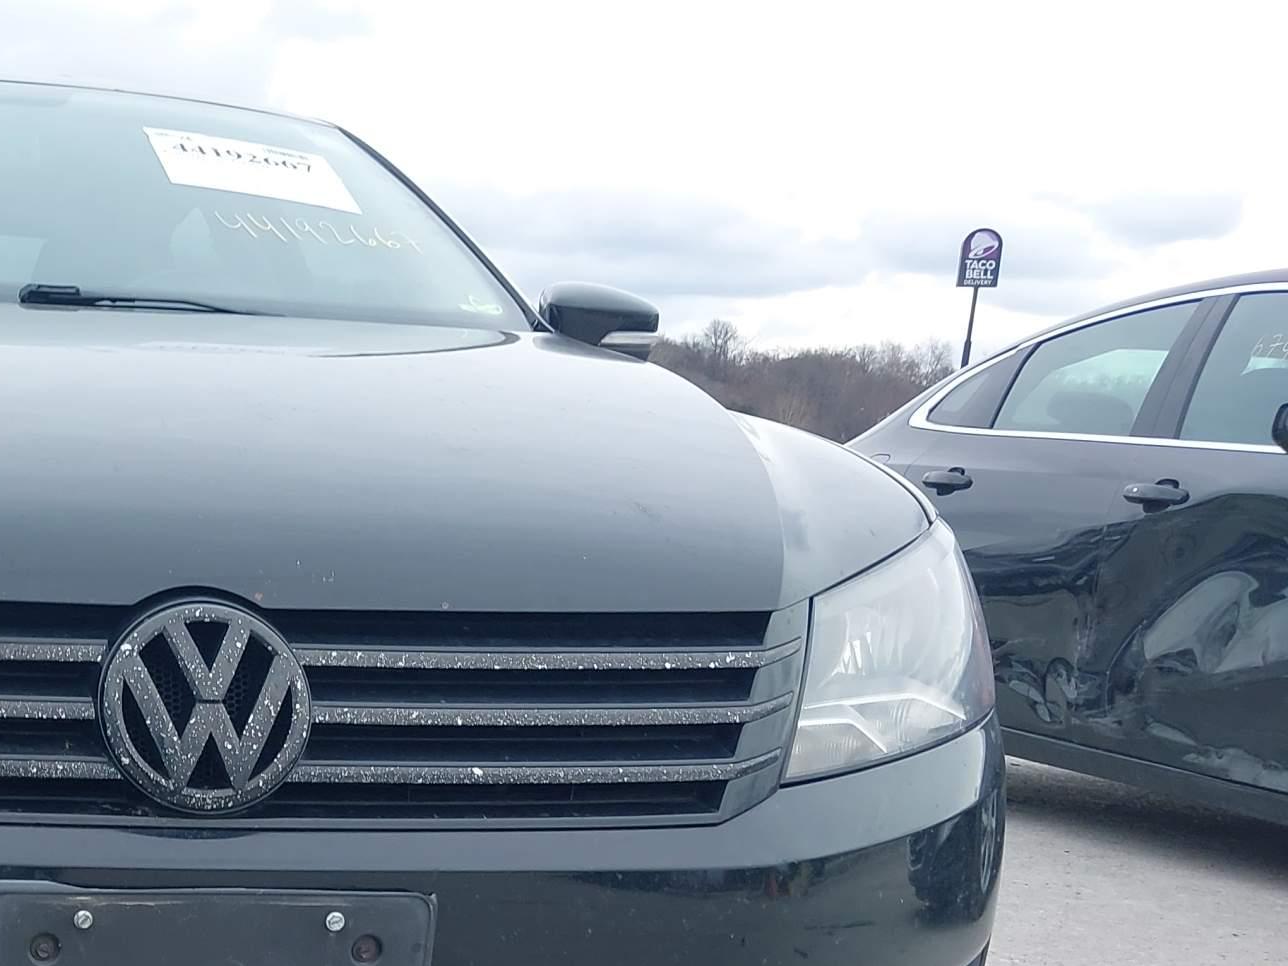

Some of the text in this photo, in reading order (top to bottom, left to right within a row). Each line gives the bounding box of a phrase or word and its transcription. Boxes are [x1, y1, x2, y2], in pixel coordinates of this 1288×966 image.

[213, 210, 424, 255] 44192667
[965, 259, 996, 270] TACO
[965, 269, 994, 279] BELL
